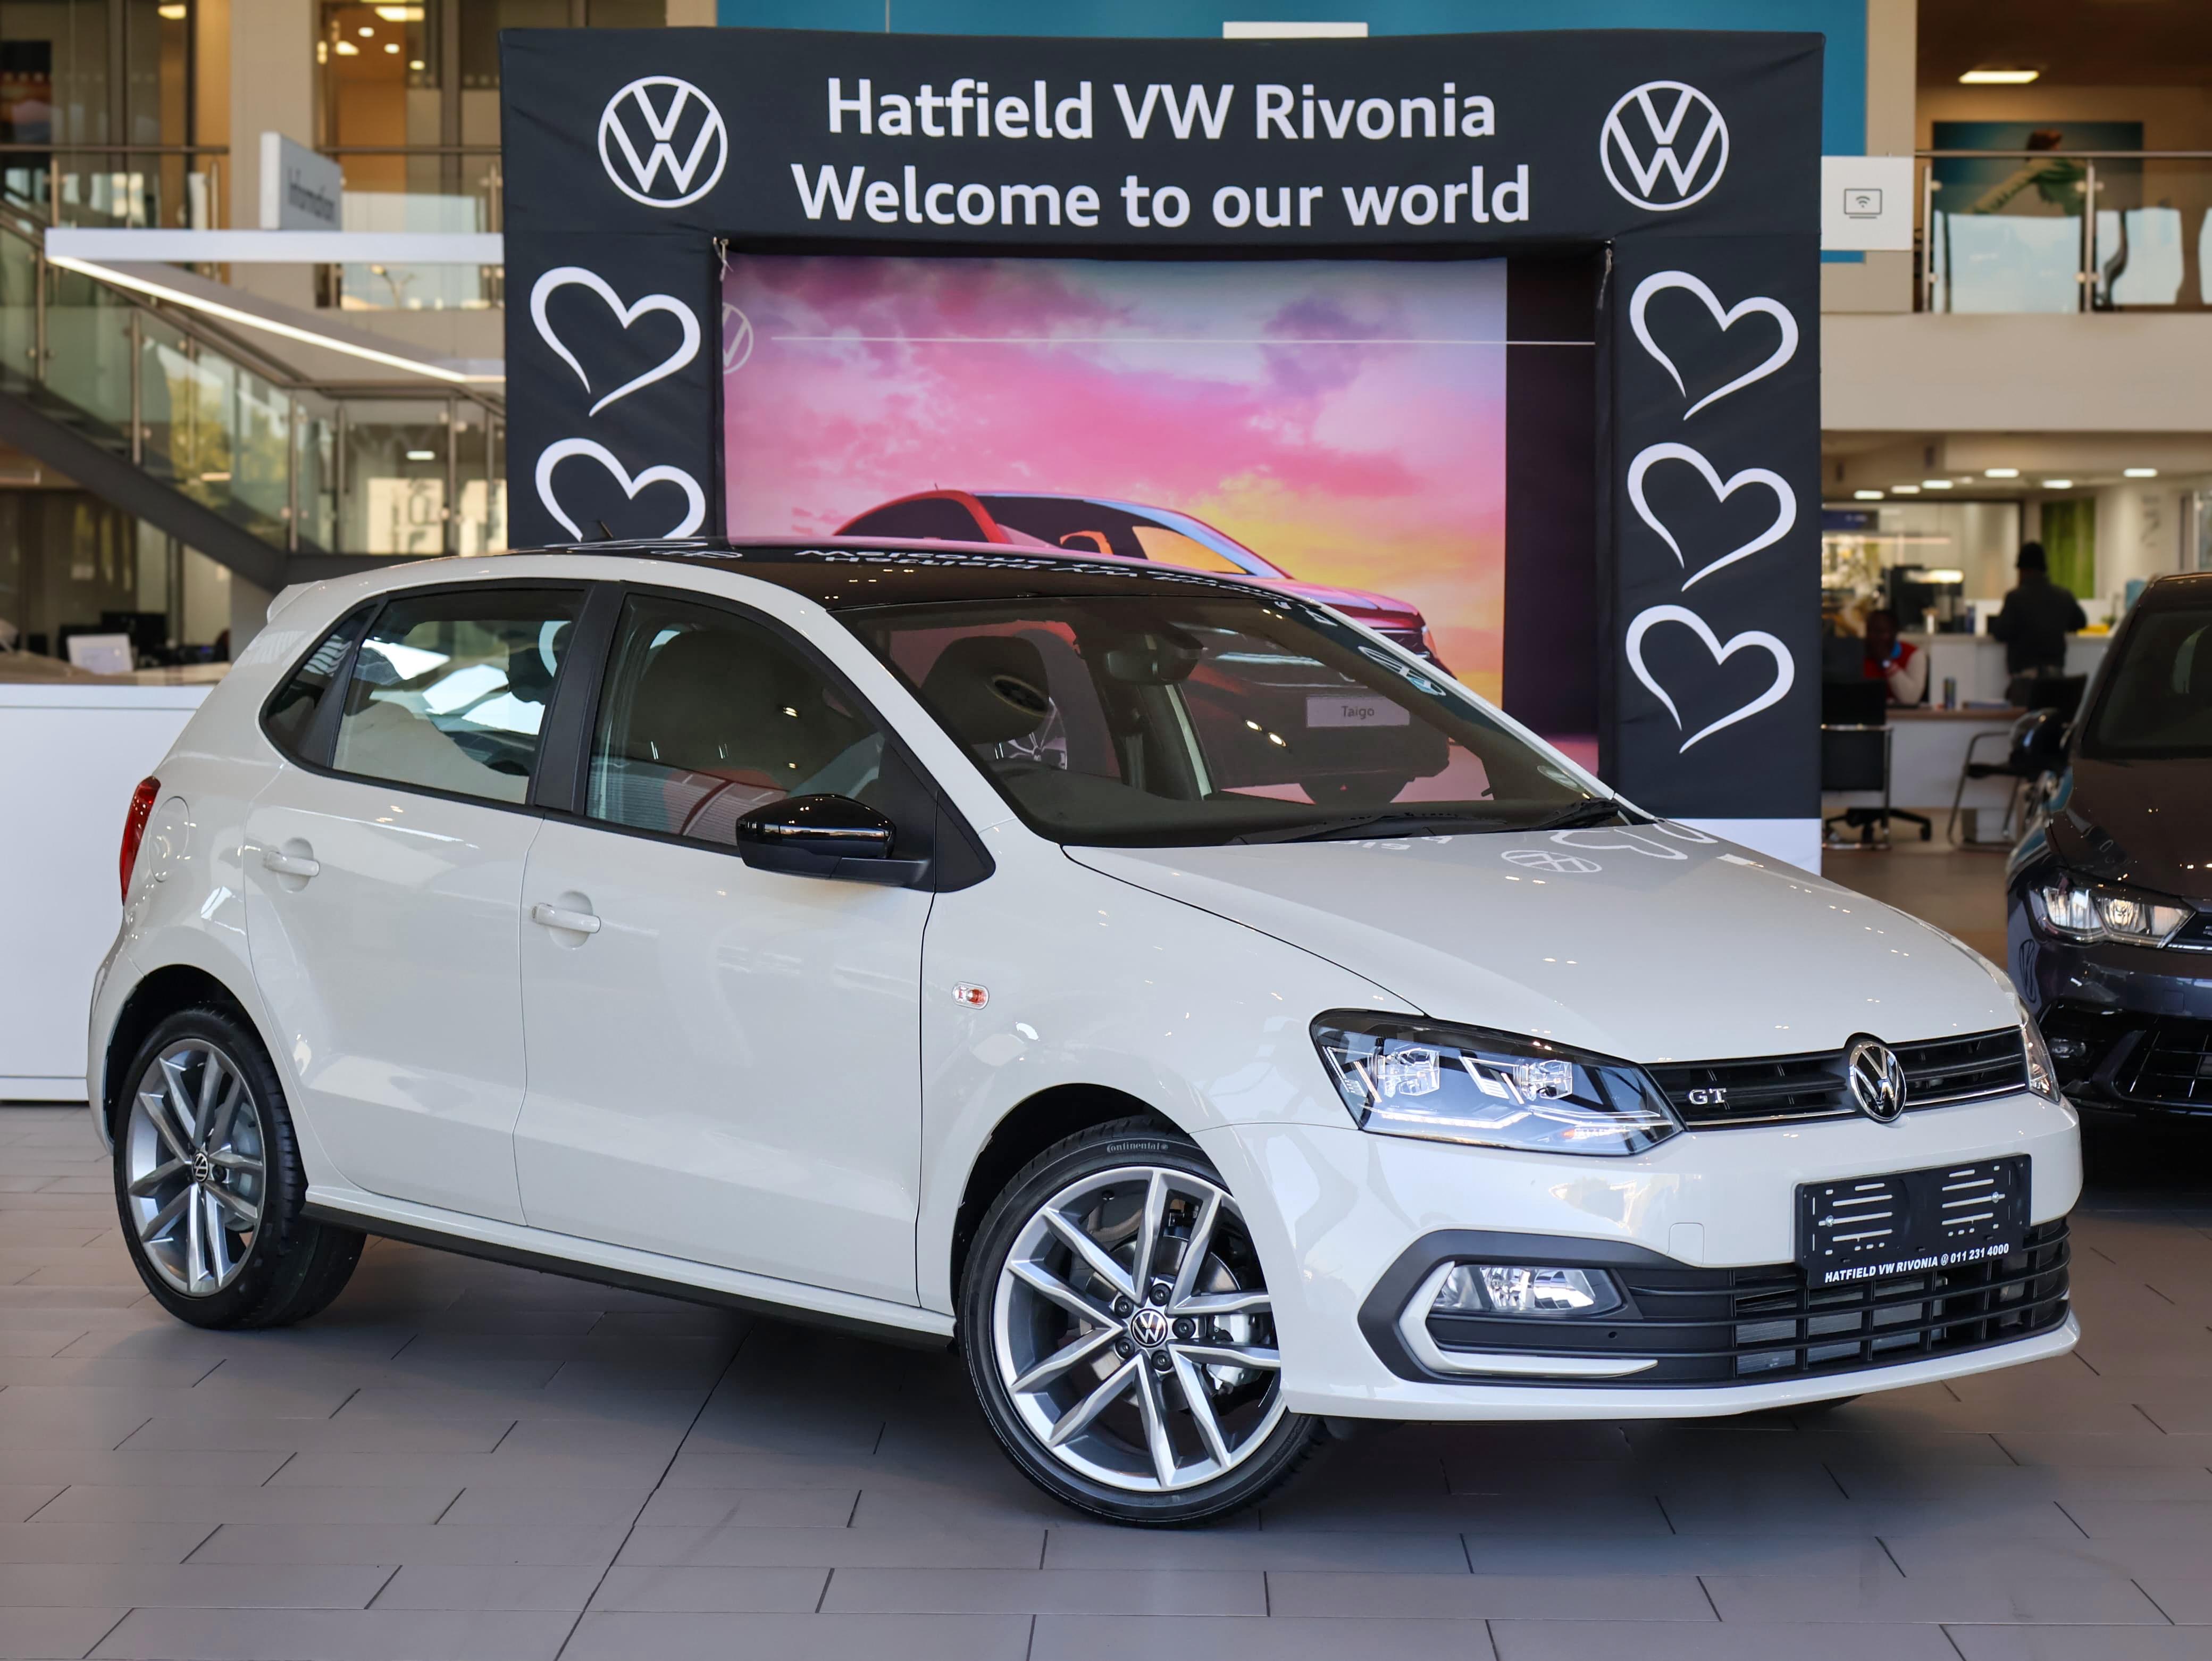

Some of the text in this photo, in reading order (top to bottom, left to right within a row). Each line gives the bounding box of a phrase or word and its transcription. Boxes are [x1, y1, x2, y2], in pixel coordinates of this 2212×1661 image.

[828, 78, 1495, 139] Hatfield VW Rivonia
[791, 163, 1529, 228] Welcome to our world
[1341, 705, 1375, 720] Taigo
[1689, 1088, 1728, 1105] GT
[1107, 1142, 1160, 1153] Continental
[1825, 1266, 1876, 1283] HATFIELD
[1879, 1263, 1895, 1275] VW
[1896, 1256, 1938, 1272] RIVONIA
[1950, 1250, 1966, 1263] 011
[1969, 1248, 1984, 1260] 231
[1987, 1243, 2009, 1256] 4000
